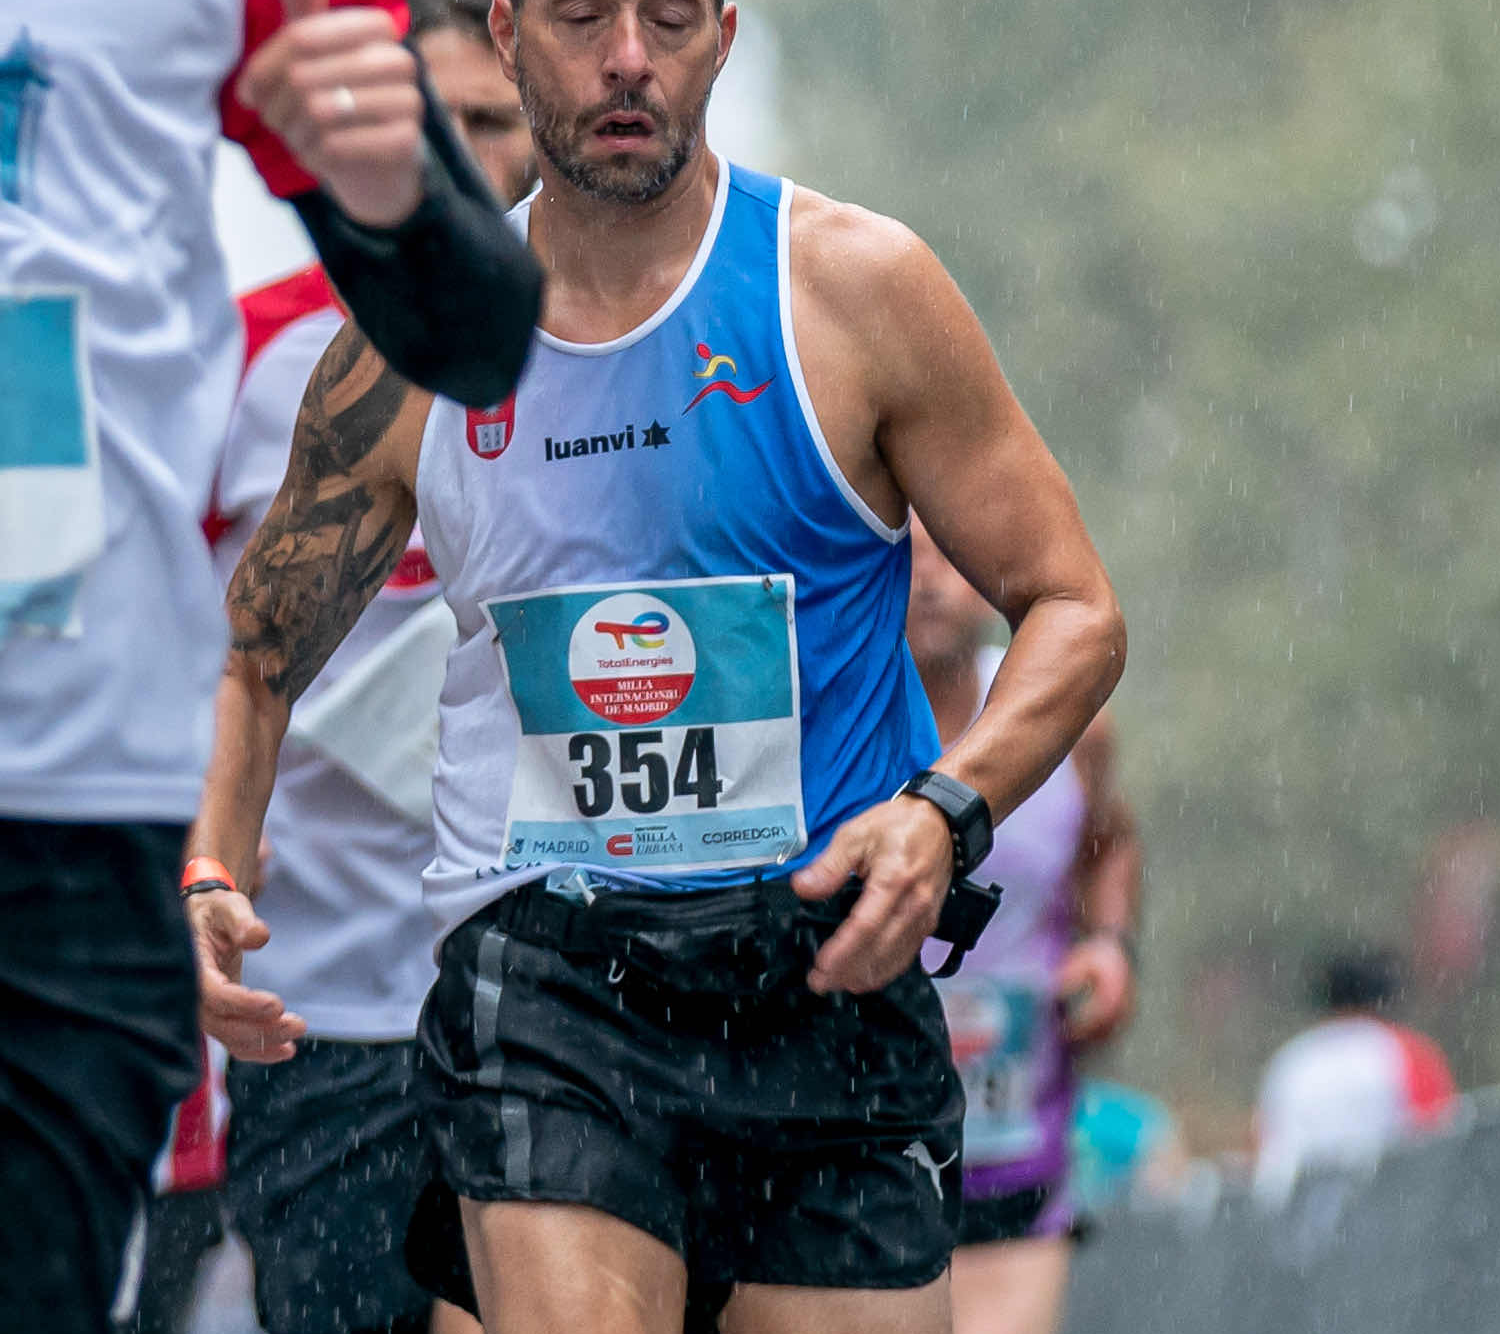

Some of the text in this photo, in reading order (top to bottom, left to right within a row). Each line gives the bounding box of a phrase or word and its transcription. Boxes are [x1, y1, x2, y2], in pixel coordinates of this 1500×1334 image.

[544, 424, 634, 461] luanvi
[597, 655, 673, 669] TotalEnergies
[617, 679, 653, 690] MILLA
[604, 704, 620, 715] DE
[568, 726, 723, 817] 354
[532, 839, 590, 854] MADRID
